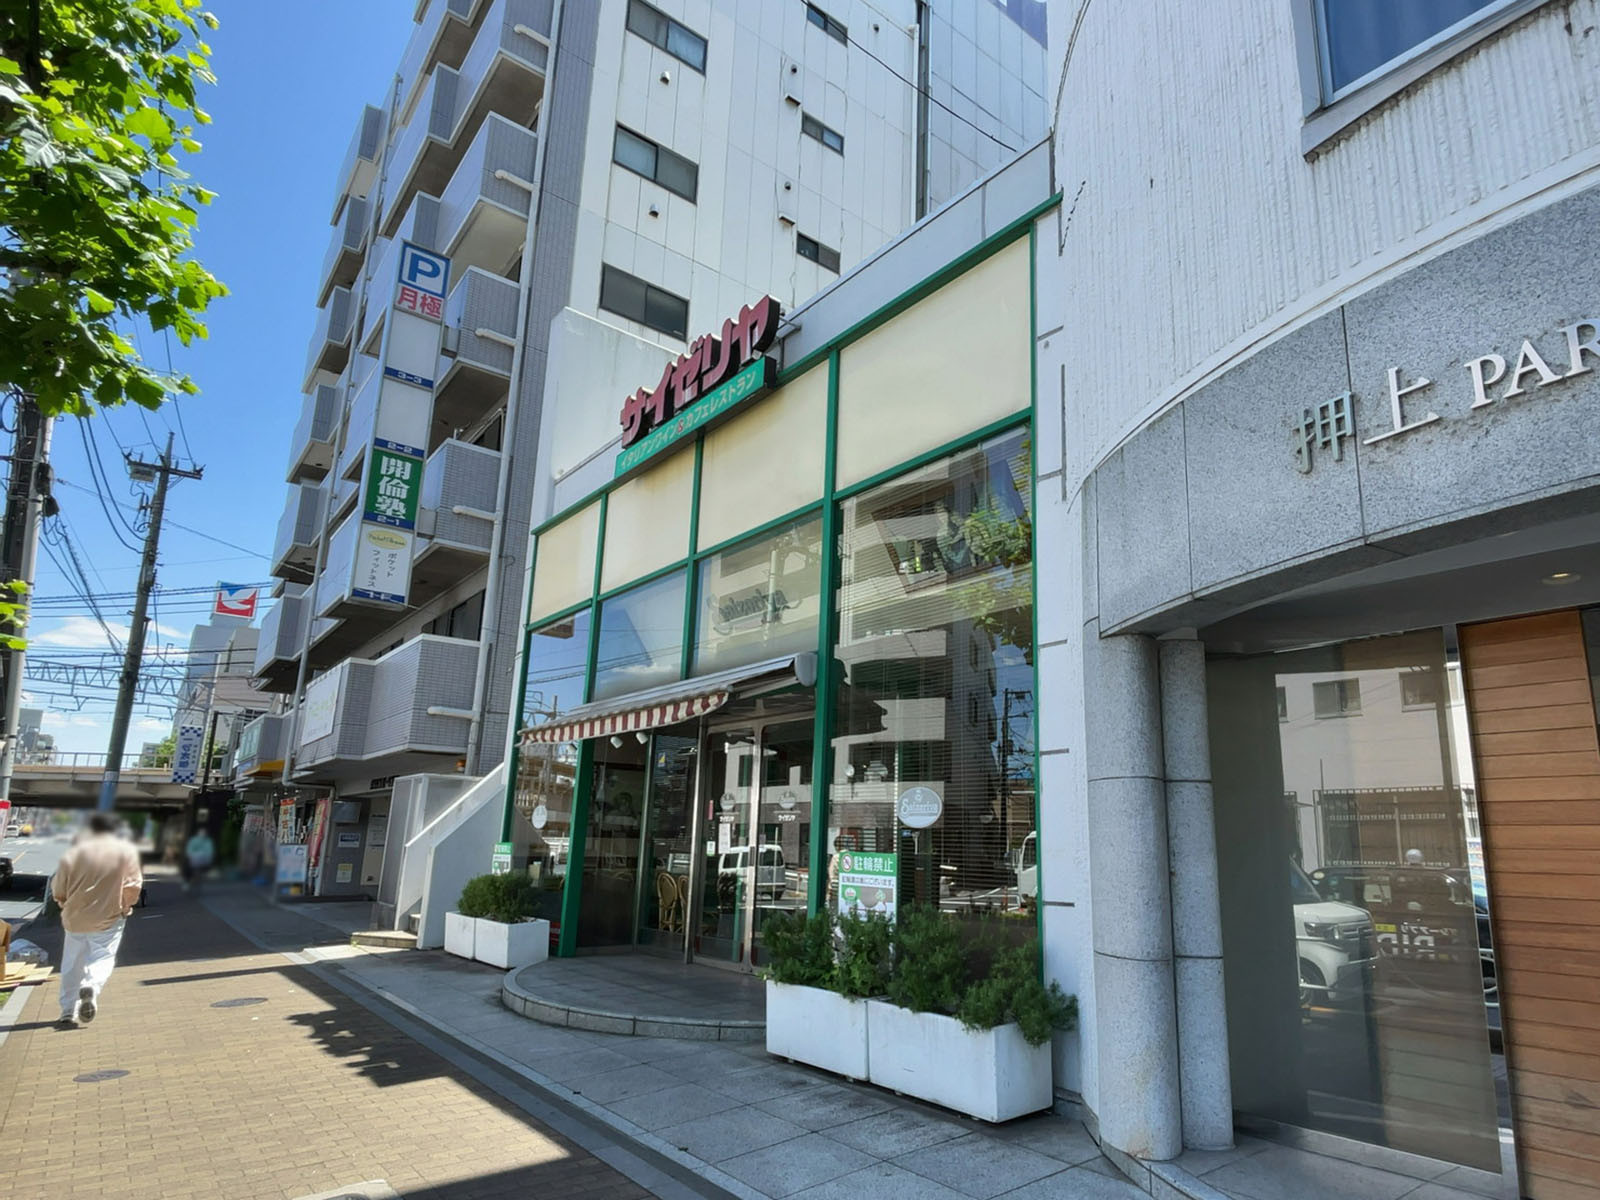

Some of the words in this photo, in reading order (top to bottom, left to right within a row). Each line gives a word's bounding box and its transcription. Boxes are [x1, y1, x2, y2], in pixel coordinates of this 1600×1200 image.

[408, 252, 440, 282] P
[397, 286, 442, 319] 月極
[397, 371, 422, 384] 3-3
[620, 295, 774, 447] サイゼリヤ
[1291, 366, 1441, 475] 押上
[853, 855, 894, 873] 駐輪禁止
